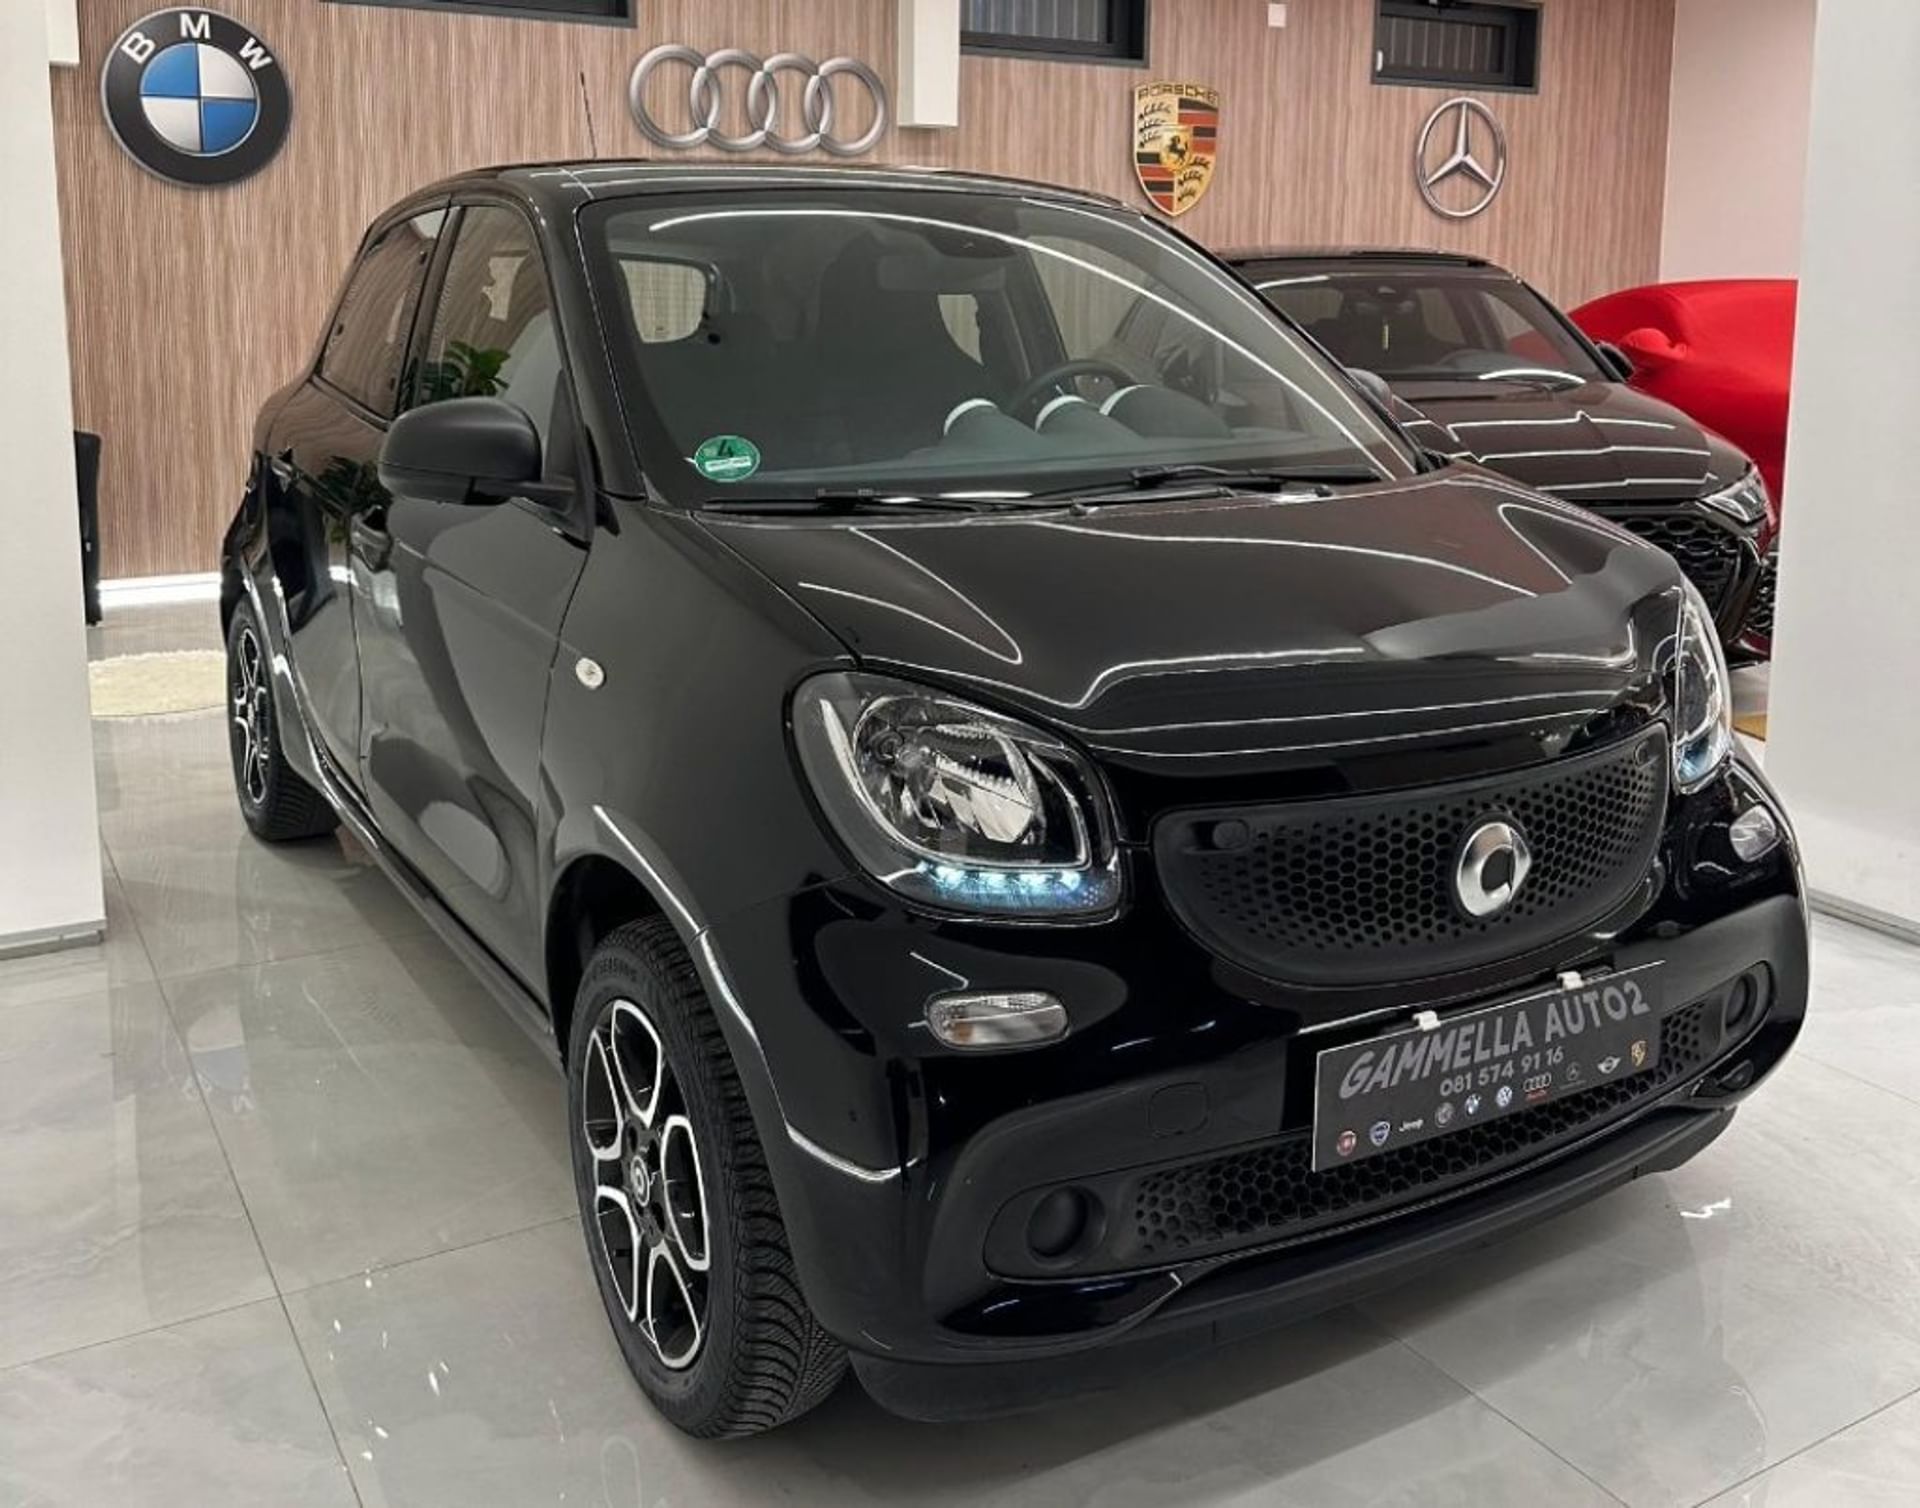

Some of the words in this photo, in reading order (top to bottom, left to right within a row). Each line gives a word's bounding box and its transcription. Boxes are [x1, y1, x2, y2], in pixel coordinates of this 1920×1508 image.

[120, 12, 273, 71] BMW
[1138, 83, 1218, 104] PORSCHE
[1339, 1010, 1533, 1099] GAMMELLA
[1545, 980, 1650, 1042] AUTO2
[1440, 1072, 1472, 1096] 081
[1478, 1060, 1514, 1086] 574
[1521, 1052, 1540, 1074] 91
[1546, 1046, 1564, 1066] 16
